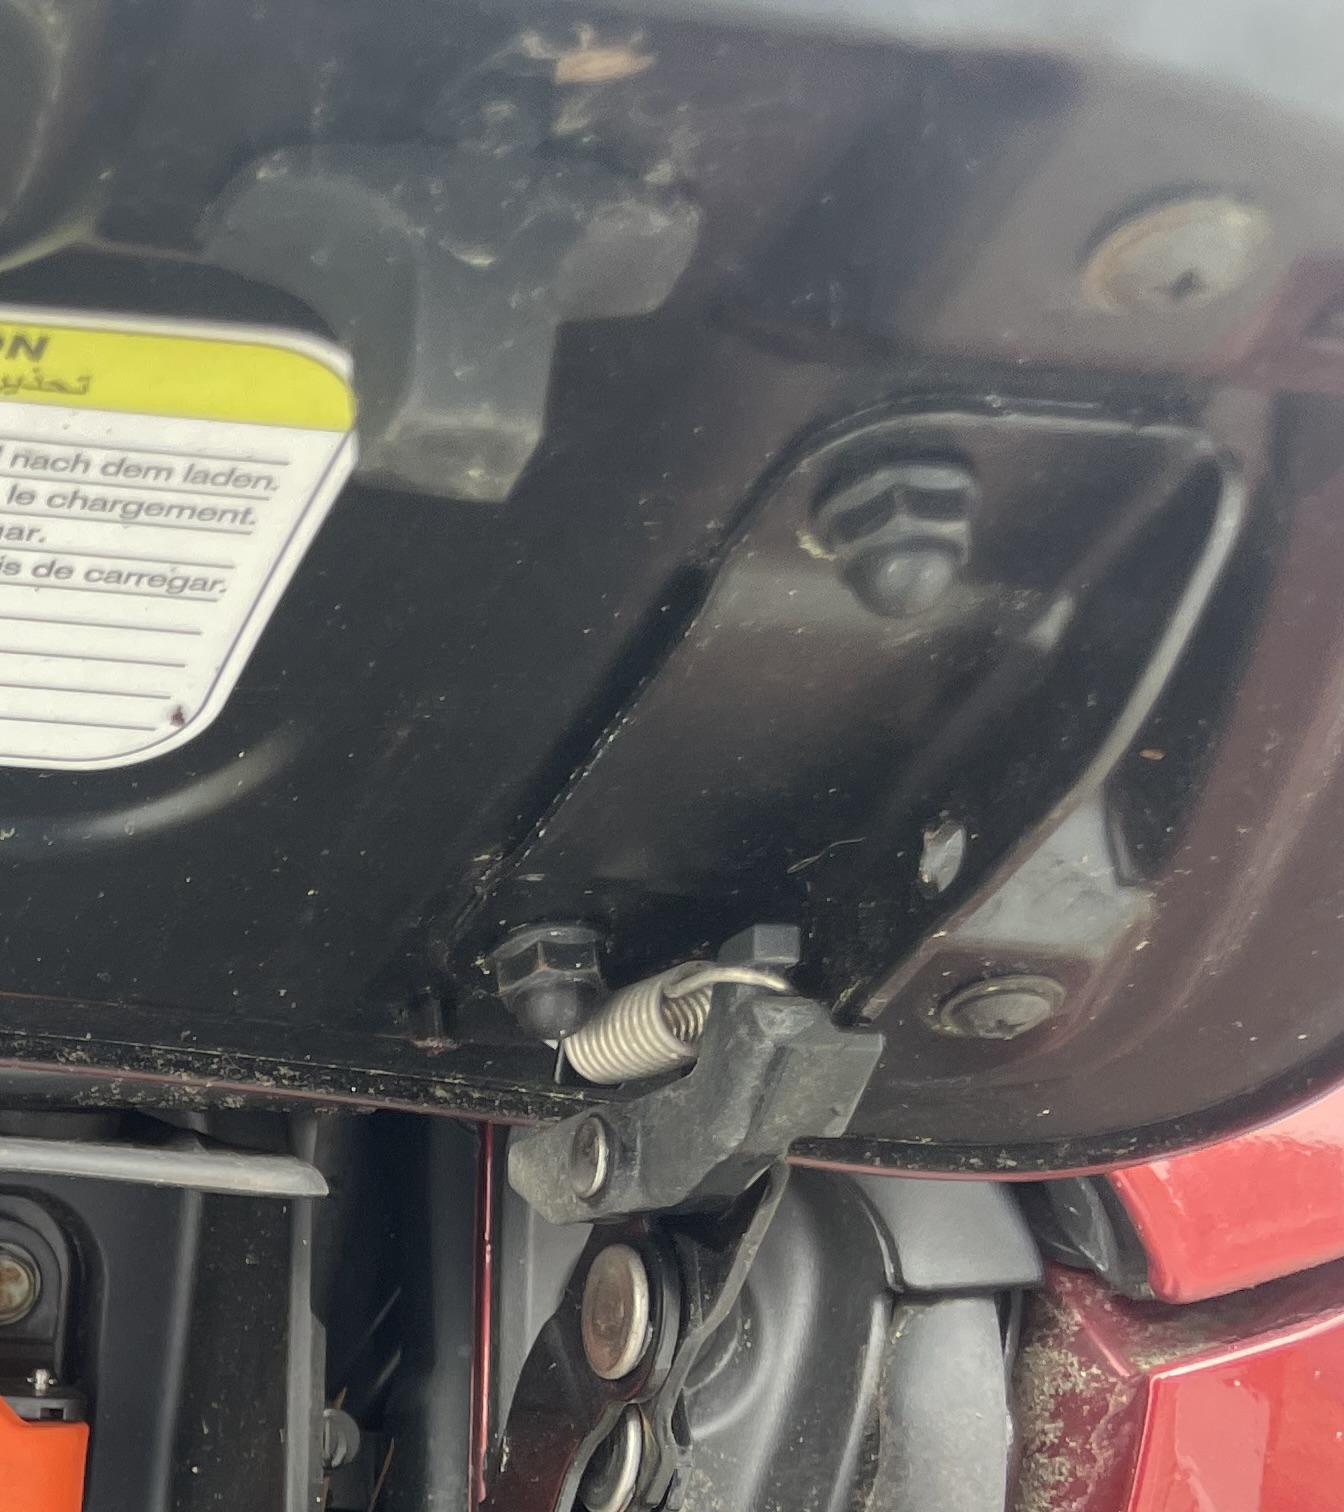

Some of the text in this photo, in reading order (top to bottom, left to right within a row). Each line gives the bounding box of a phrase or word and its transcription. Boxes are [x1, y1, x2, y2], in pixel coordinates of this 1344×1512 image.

[10, 450, 91, 475] nach
[100, 456, 173, 482] dem
[182, 462, 279, 492] laden.
[7, 483, 42, 507] le
[46, 488, 257, 526] chargement.
[31, 560, 74, 580] de
[83, 568, 228, 596] carregar.
